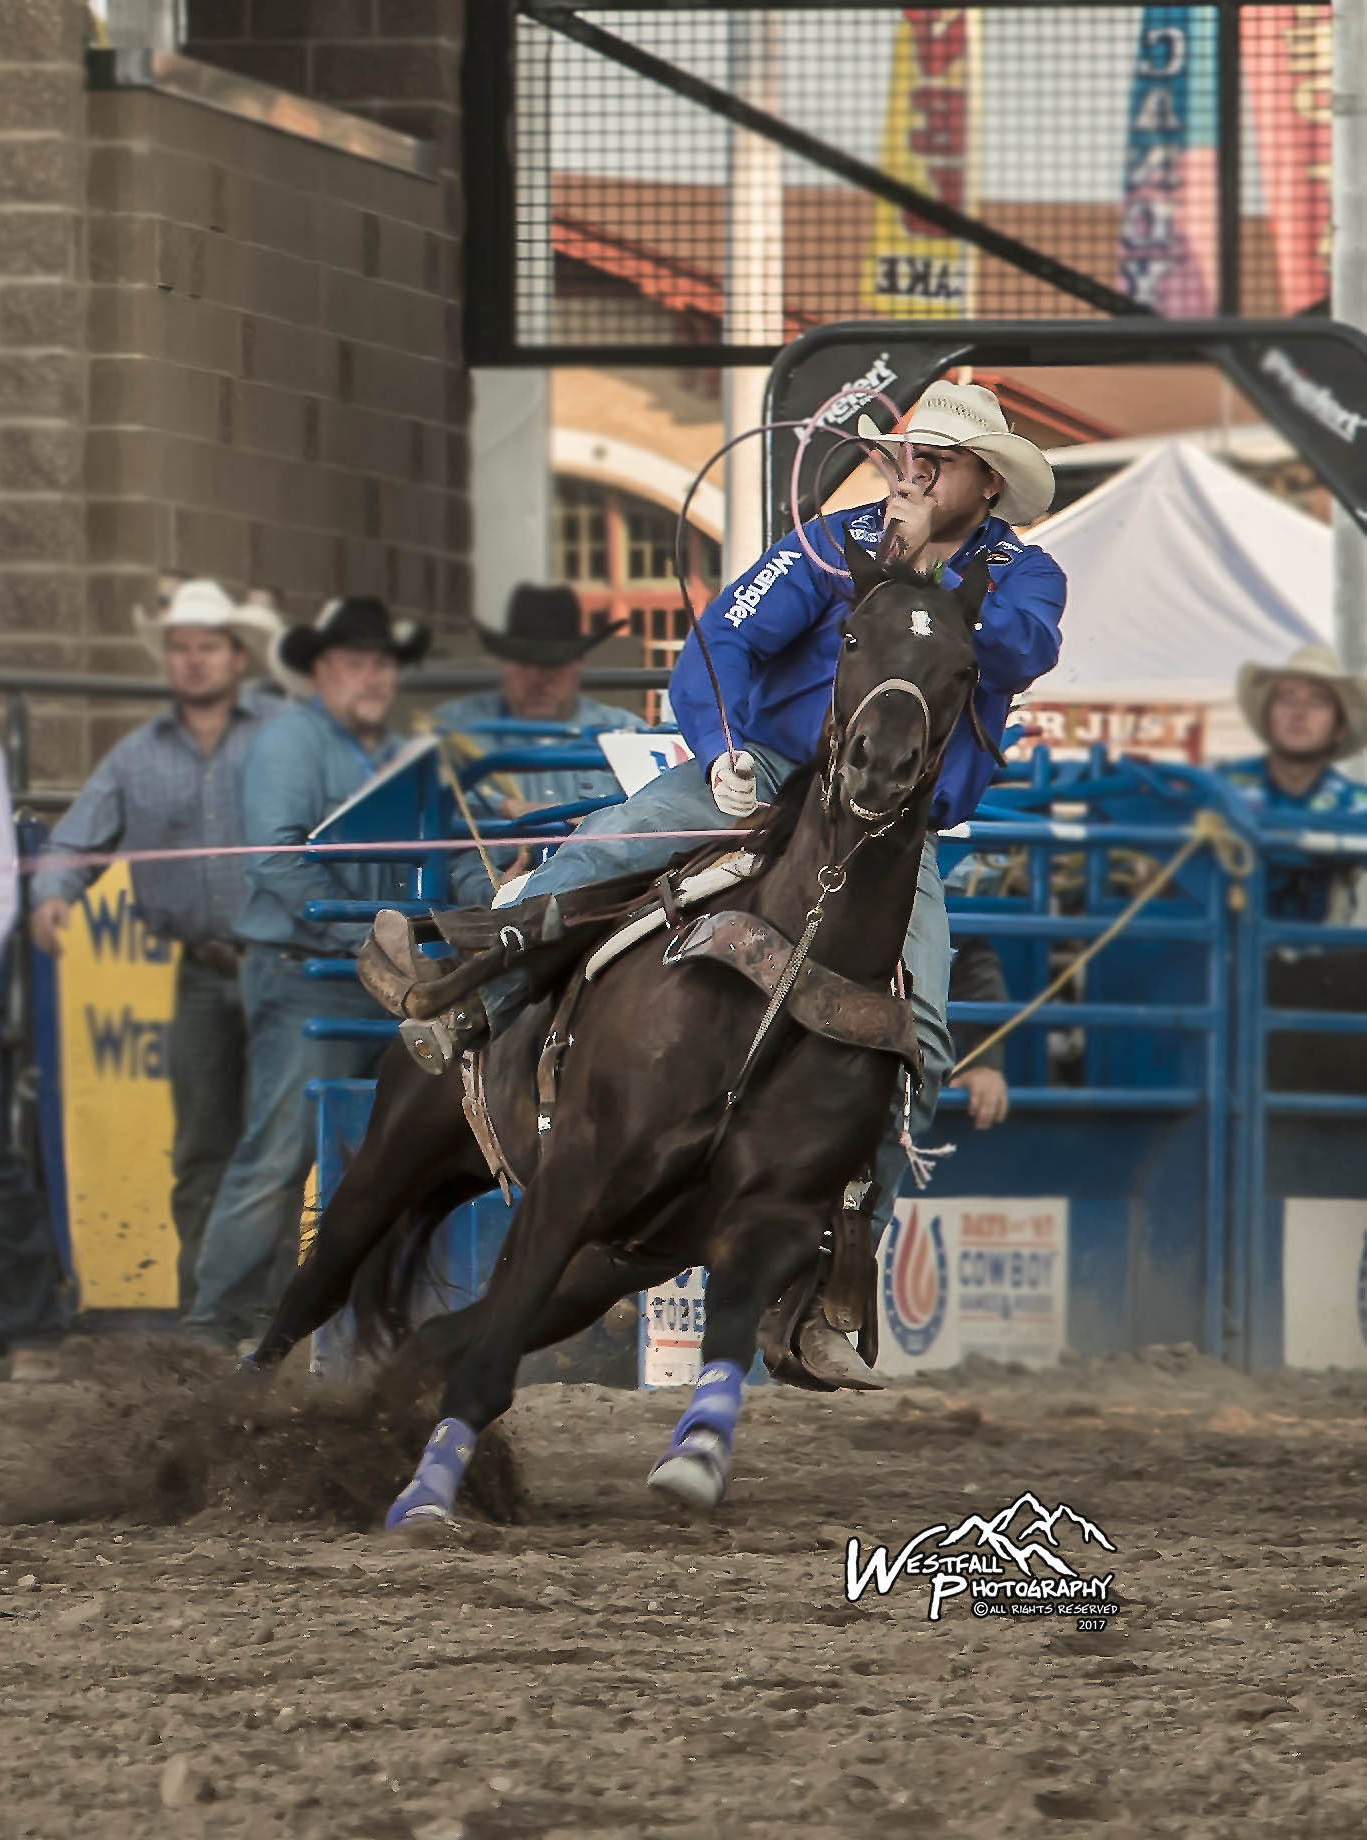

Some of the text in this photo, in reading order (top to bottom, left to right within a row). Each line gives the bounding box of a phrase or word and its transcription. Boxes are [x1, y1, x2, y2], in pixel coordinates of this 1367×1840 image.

[724, 551, 802, 628] Wrangler
[1074, 708, 1197, 742] JUST
[960, 1249, 1059, 1288] COWBOY
[651, 1296, 706, 1333] RODE
